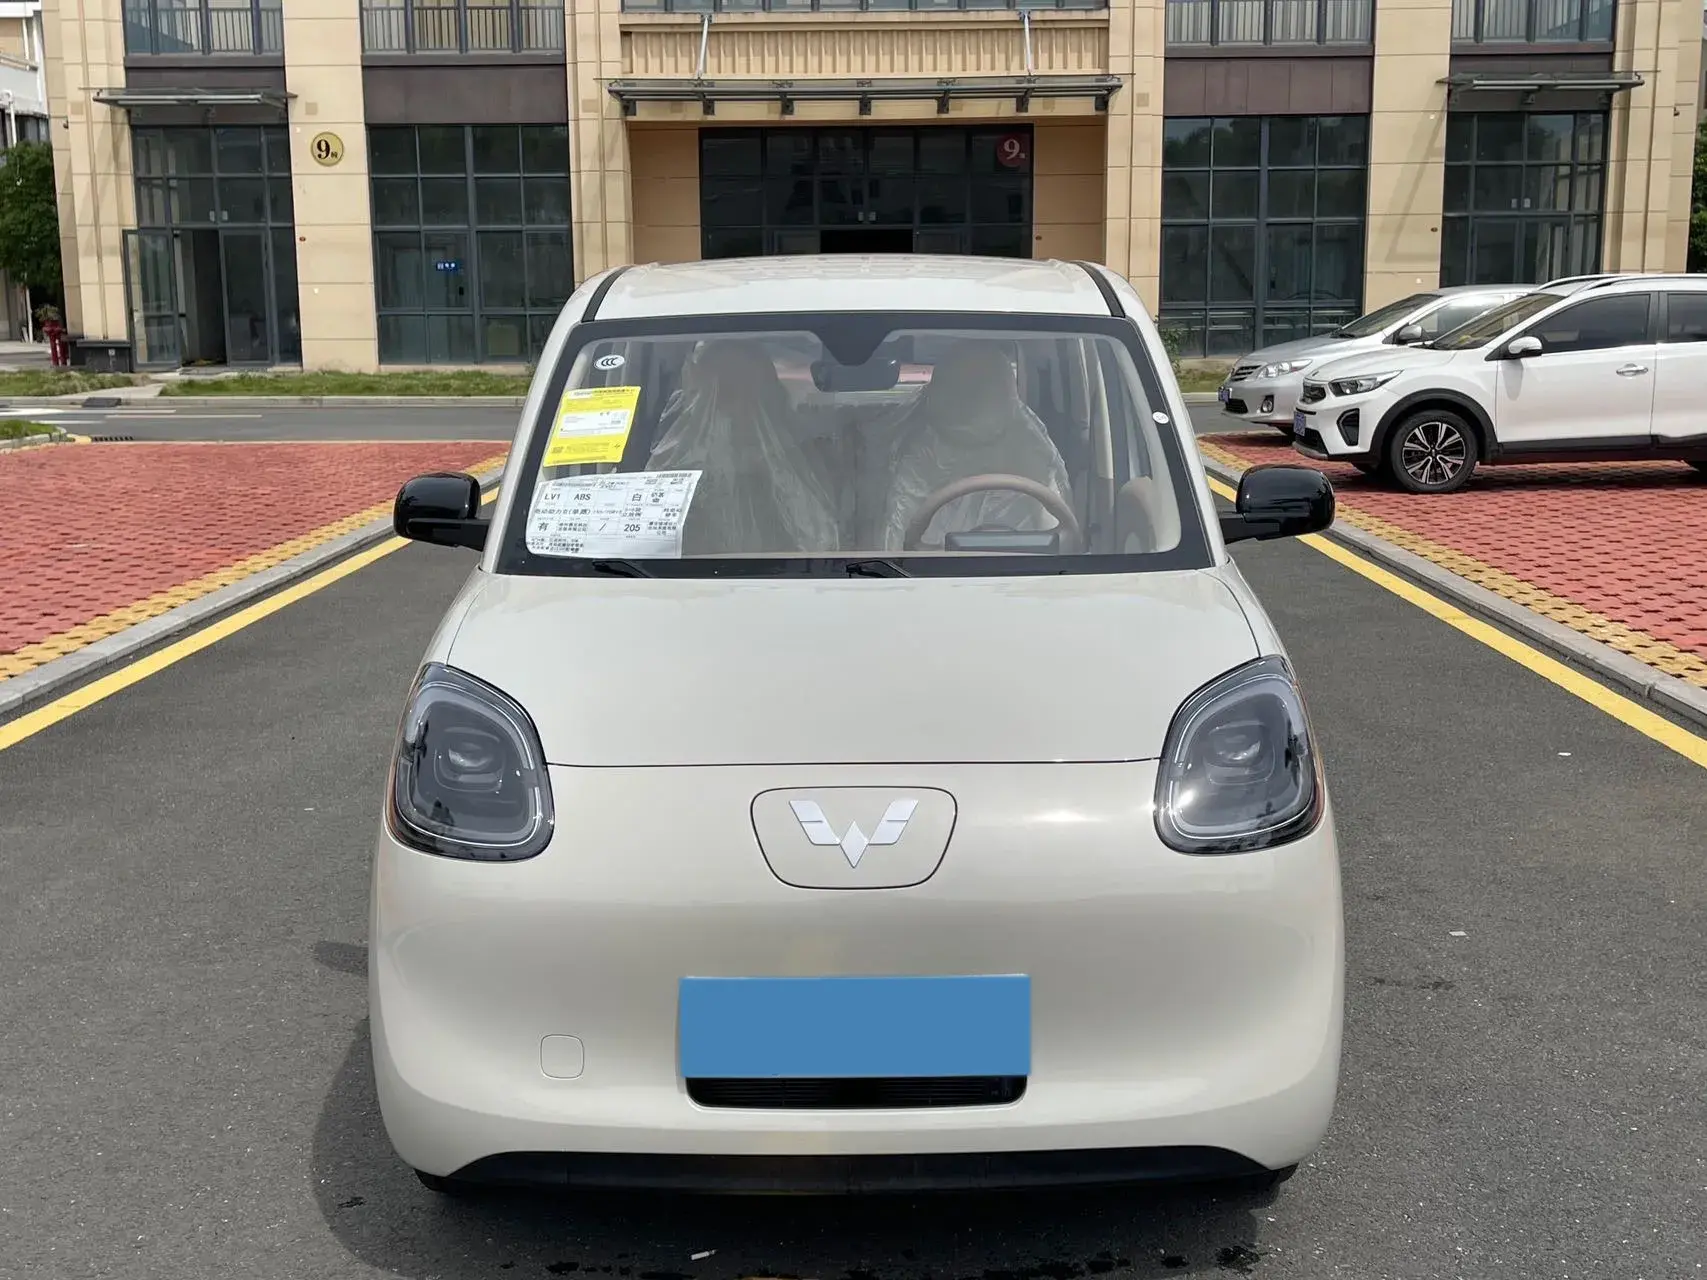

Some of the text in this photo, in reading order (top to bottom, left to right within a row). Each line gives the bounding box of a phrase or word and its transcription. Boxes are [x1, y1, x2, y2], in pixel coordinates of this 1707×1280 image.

[573, 493, 592, 501] ABS
[632, 493, 642, 502] 白
[623, 523, 641, 532] 205
